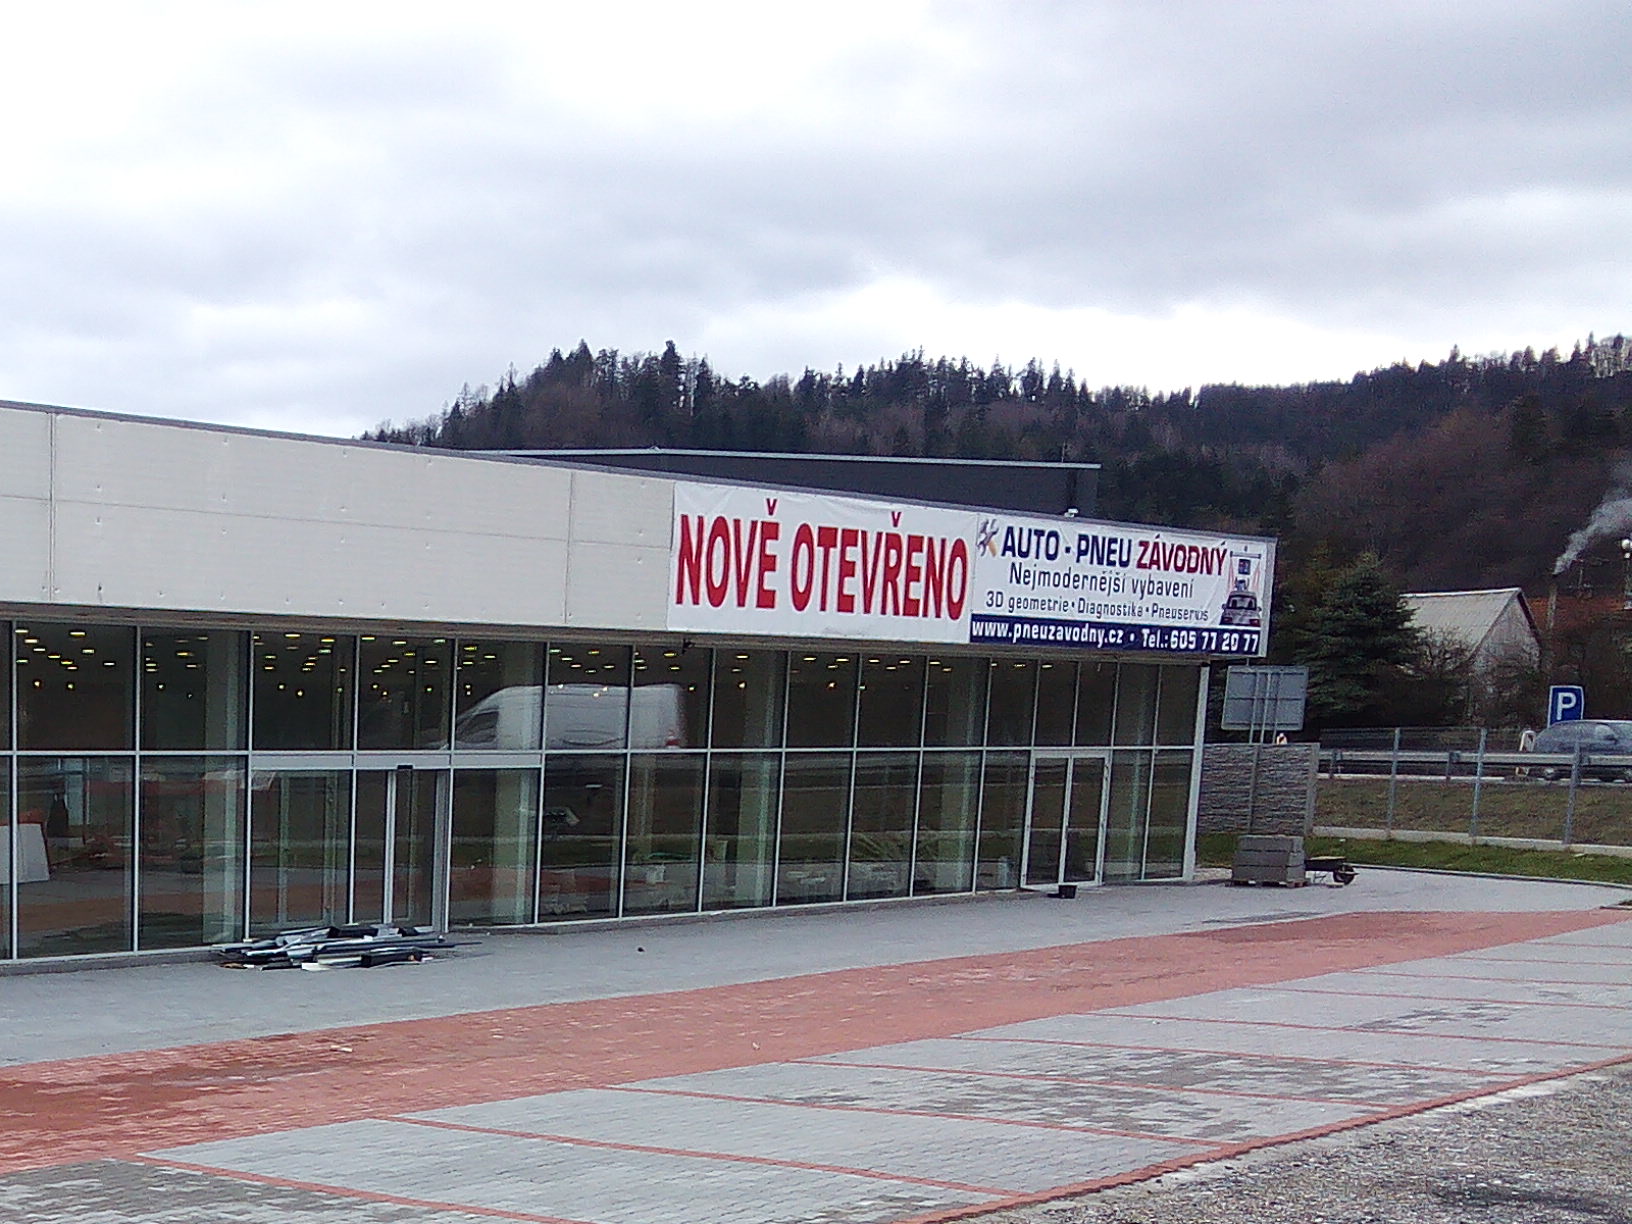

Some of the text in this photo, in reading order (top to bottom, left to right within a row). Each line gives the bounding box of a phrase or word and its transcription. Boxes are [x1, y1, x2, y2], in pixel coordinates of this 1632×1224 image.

[674, 497, 968, 621] NOVĚ OTEVŘENO
[1001, 525, 1060, 561] AUTO
[1075, 533, 1132, 568] PNEU
[1136, 533, 1228, 576] ZÁVODNÝ
[1009, 562, 1194, 600] Nejmodernější vybavení
[986, 591, 1004, 608] 3D
[1008, 595, 1069, 613] geometrie
[1077, 597, 1143, 619] Diagnostika
[971, 620, 1124, 648] www.pneuzavodny.cz
[1202, 631, 1218, 651] 77
[1221, 632, 1239, 652] 20
[1243, 633, 1259, 653] 77
[1556, 692, 1577, 721] P
